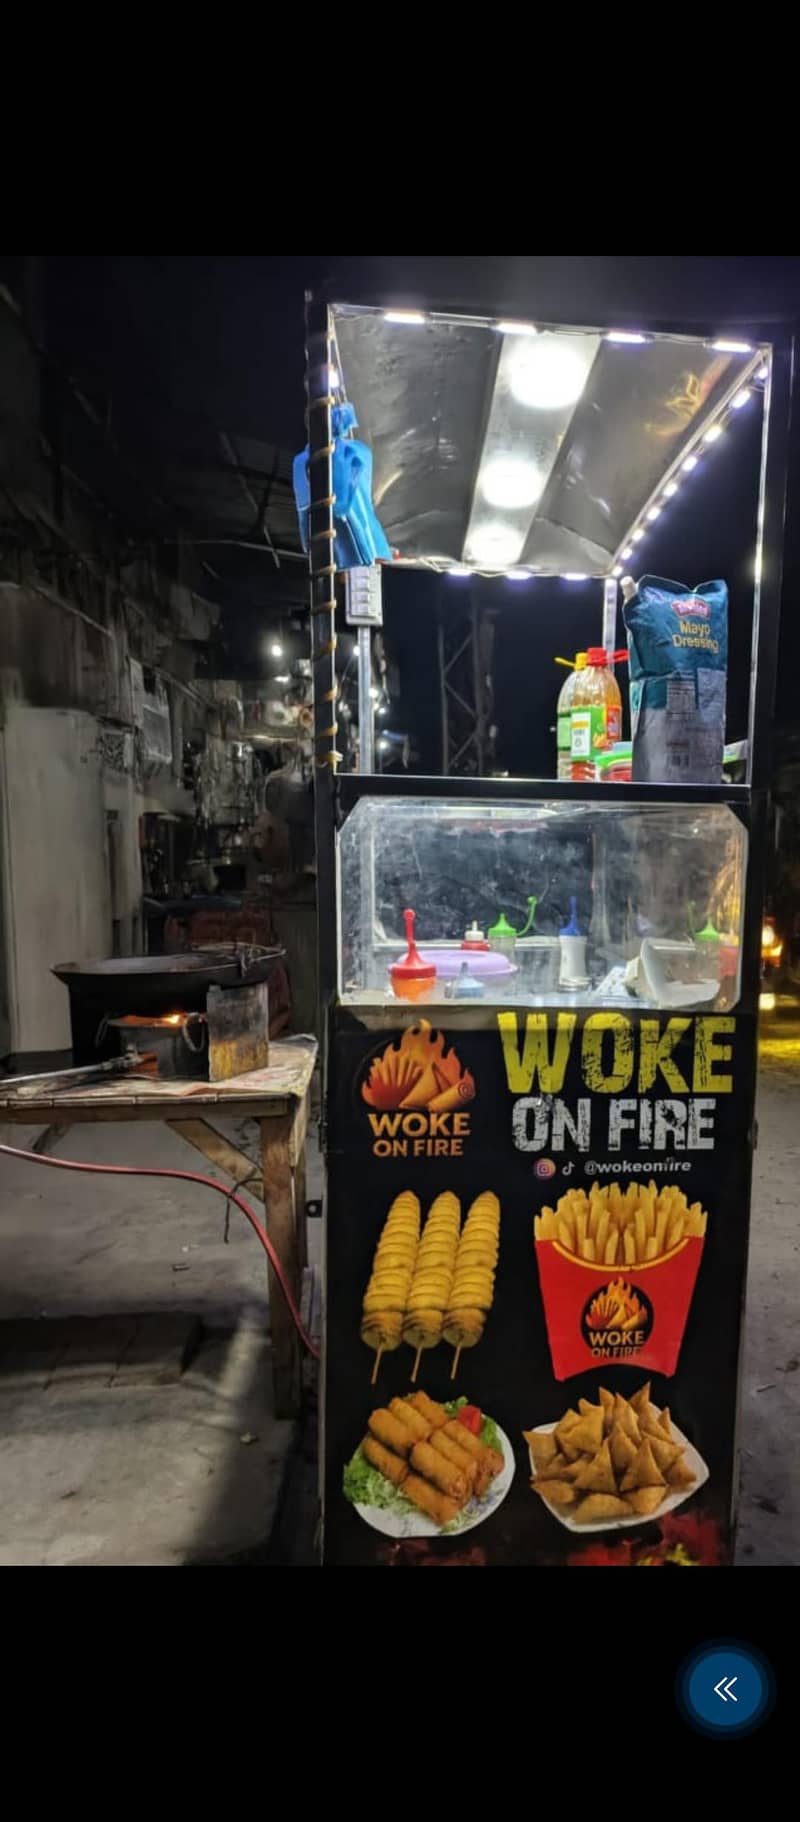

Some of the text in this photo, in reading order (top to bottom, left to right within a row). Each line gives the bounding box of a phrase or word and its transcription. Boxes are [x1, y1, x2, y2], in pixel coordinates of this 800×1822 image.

[680, 619, 710, 637] Mayo
[672, 634, 719, 653] Dressing
[497, 1012, 736, 1093] WOKE
[368, 1113, 471, 1136] WOKE
[512, 1098, 716, 1152] ON FIRE
[372, 1139, 464, 1157] ON FIRE
[589, 1331, 644, 1346] WOKE
[591, 1347, 610, 1359] ON
